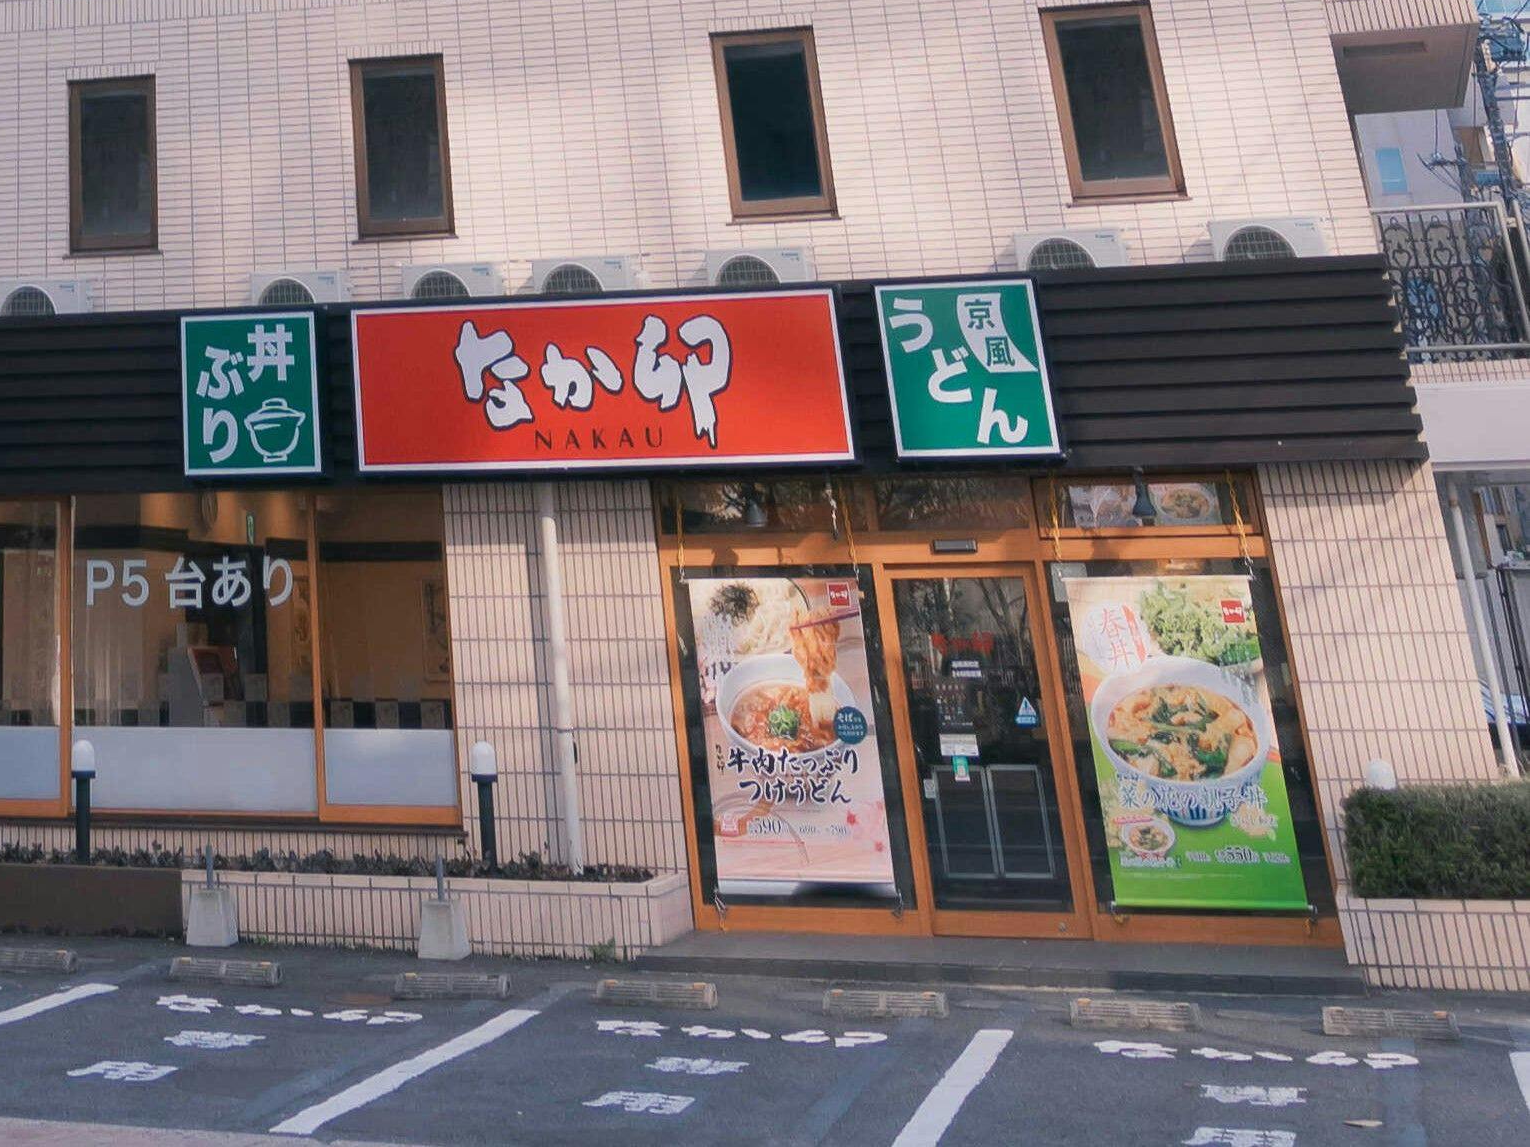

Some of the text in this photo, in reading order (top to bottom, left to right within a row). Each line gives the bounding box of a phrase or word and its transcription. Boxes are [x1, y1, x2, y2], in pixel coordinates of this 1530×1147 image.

[964, 298, 1016, 367] 京風
[454, 314, 732, 449] なか卯
[889, 297, 1029, 445] うどん
[534, 426, 663, 450] NAKAU
[739, 779, 852, 804] つけうどん
